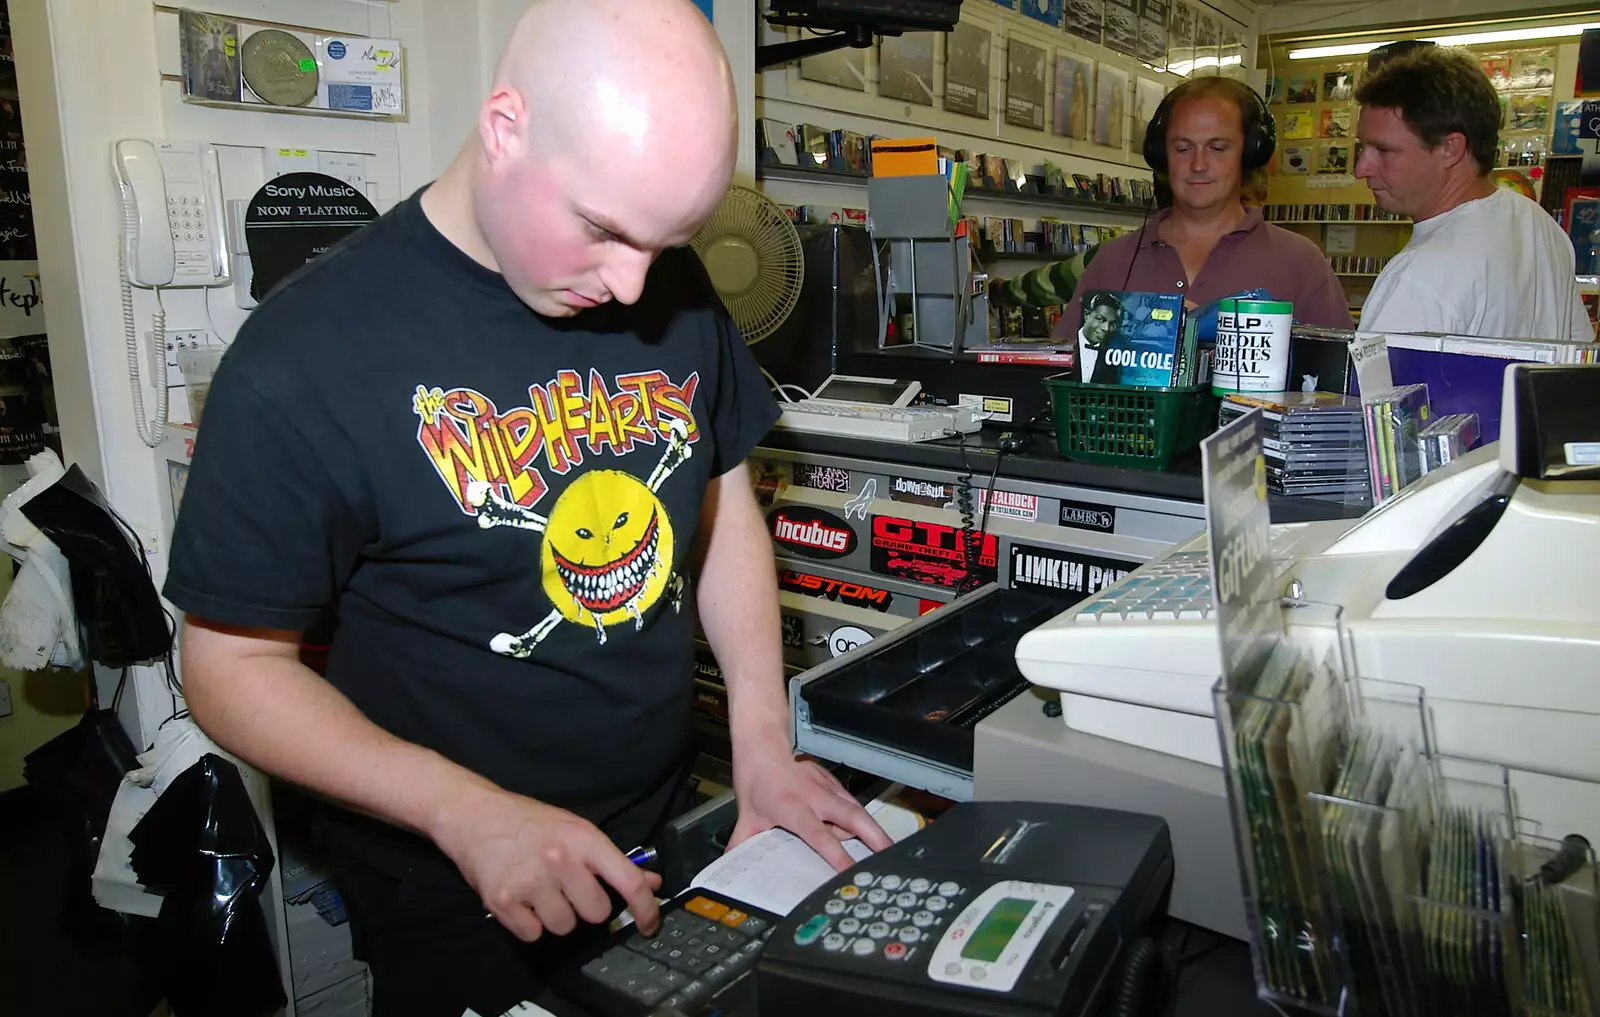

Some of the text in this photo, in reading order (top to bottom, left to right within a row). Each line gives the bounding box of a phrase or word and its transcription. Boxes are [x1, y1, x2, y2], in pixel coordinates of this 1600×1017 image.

[264, 184, 356, 199] Sony Music
[256, 205, 368, 217] NOW PLAYING...
[1217, 316, 1262, 329] HELP
[1105, 348, 1137, 367] COOL
[1140, 351, 1173, 370] COLE
[1214, 359, 1261, 373] PPEAL
[411, 383, 446, 426] the
[982, 489, 1034, 509] TTALROCK
[1063, 508, 1099, 525] LAMBS
[775, 516, 848, 550] incubus
[873, 515, 997, 558] GTA
[873, 538, 913, 552] GRAND
[918, 547, 954, 560] THEFT
[1015, 553, 1084, 592] LINKIN
[784, 569, 889, 604] USTOM
